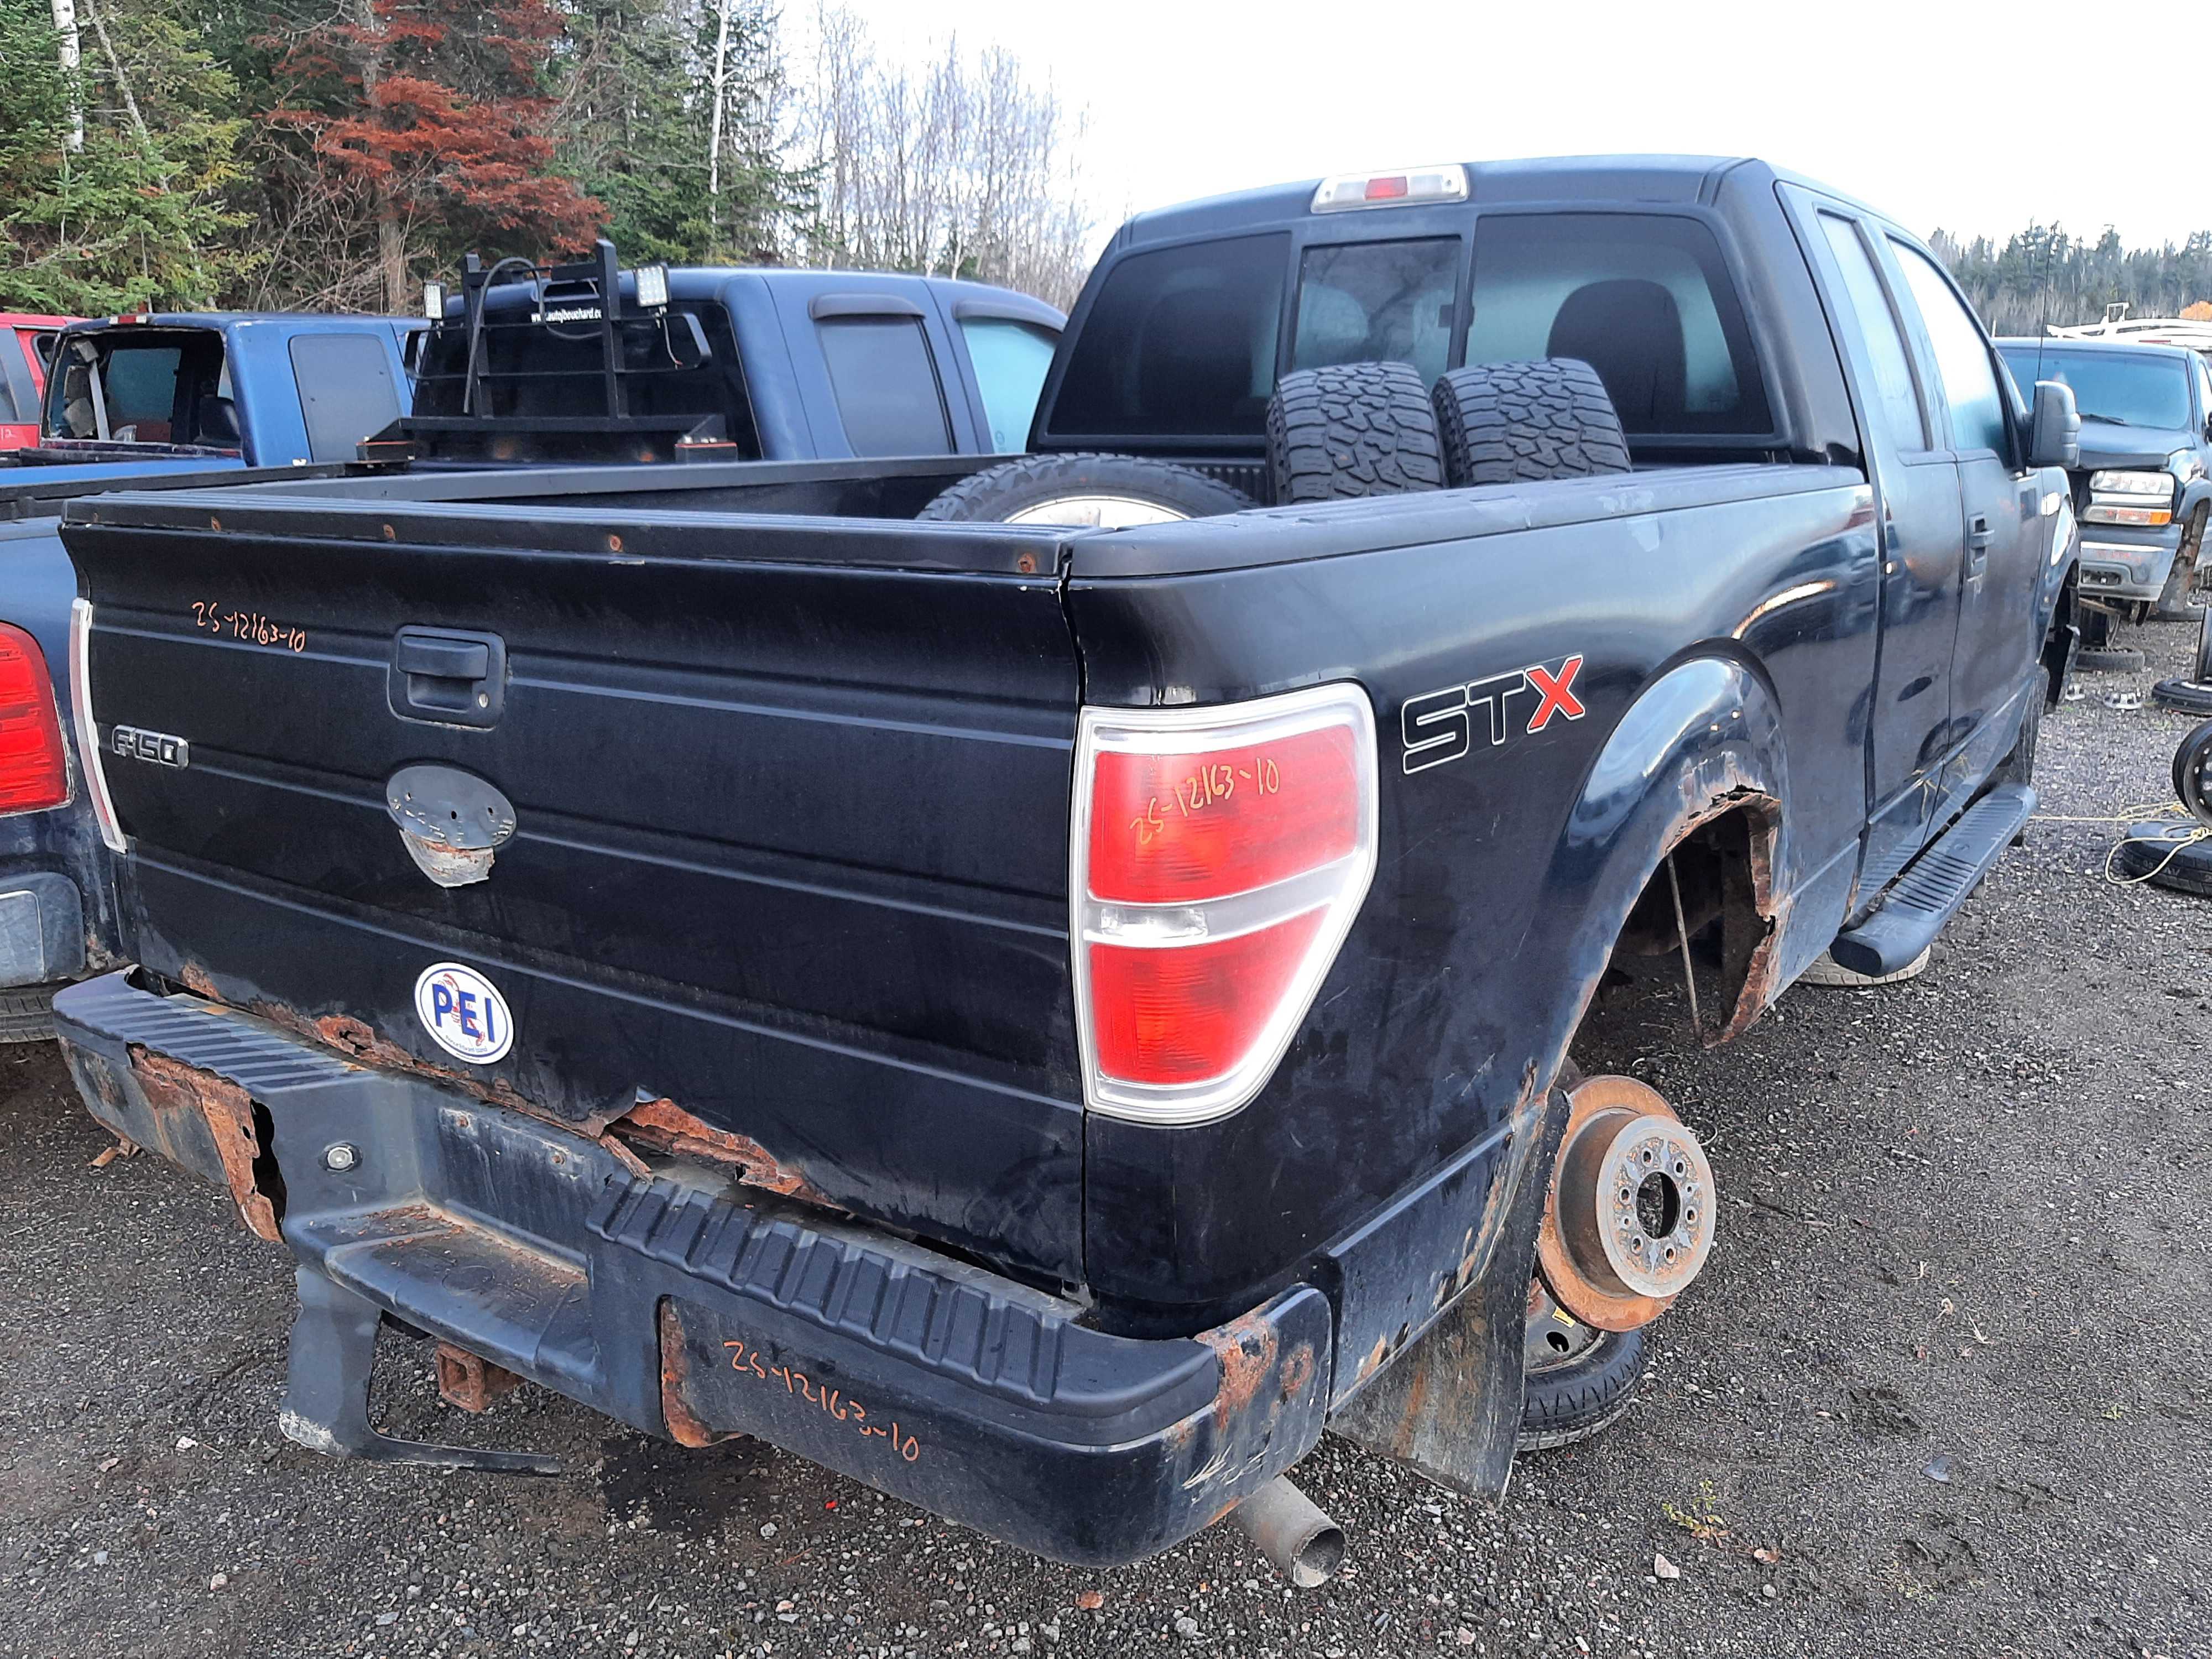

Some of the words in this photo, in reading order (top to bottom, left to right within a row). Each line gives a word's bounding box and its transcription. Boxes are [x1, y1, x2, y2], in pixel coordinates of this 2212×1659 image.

[1401, 654, 1585, 774] STX
[112, 724, 189, 768] F-150
[431, 983, 495, 1044] PEI
